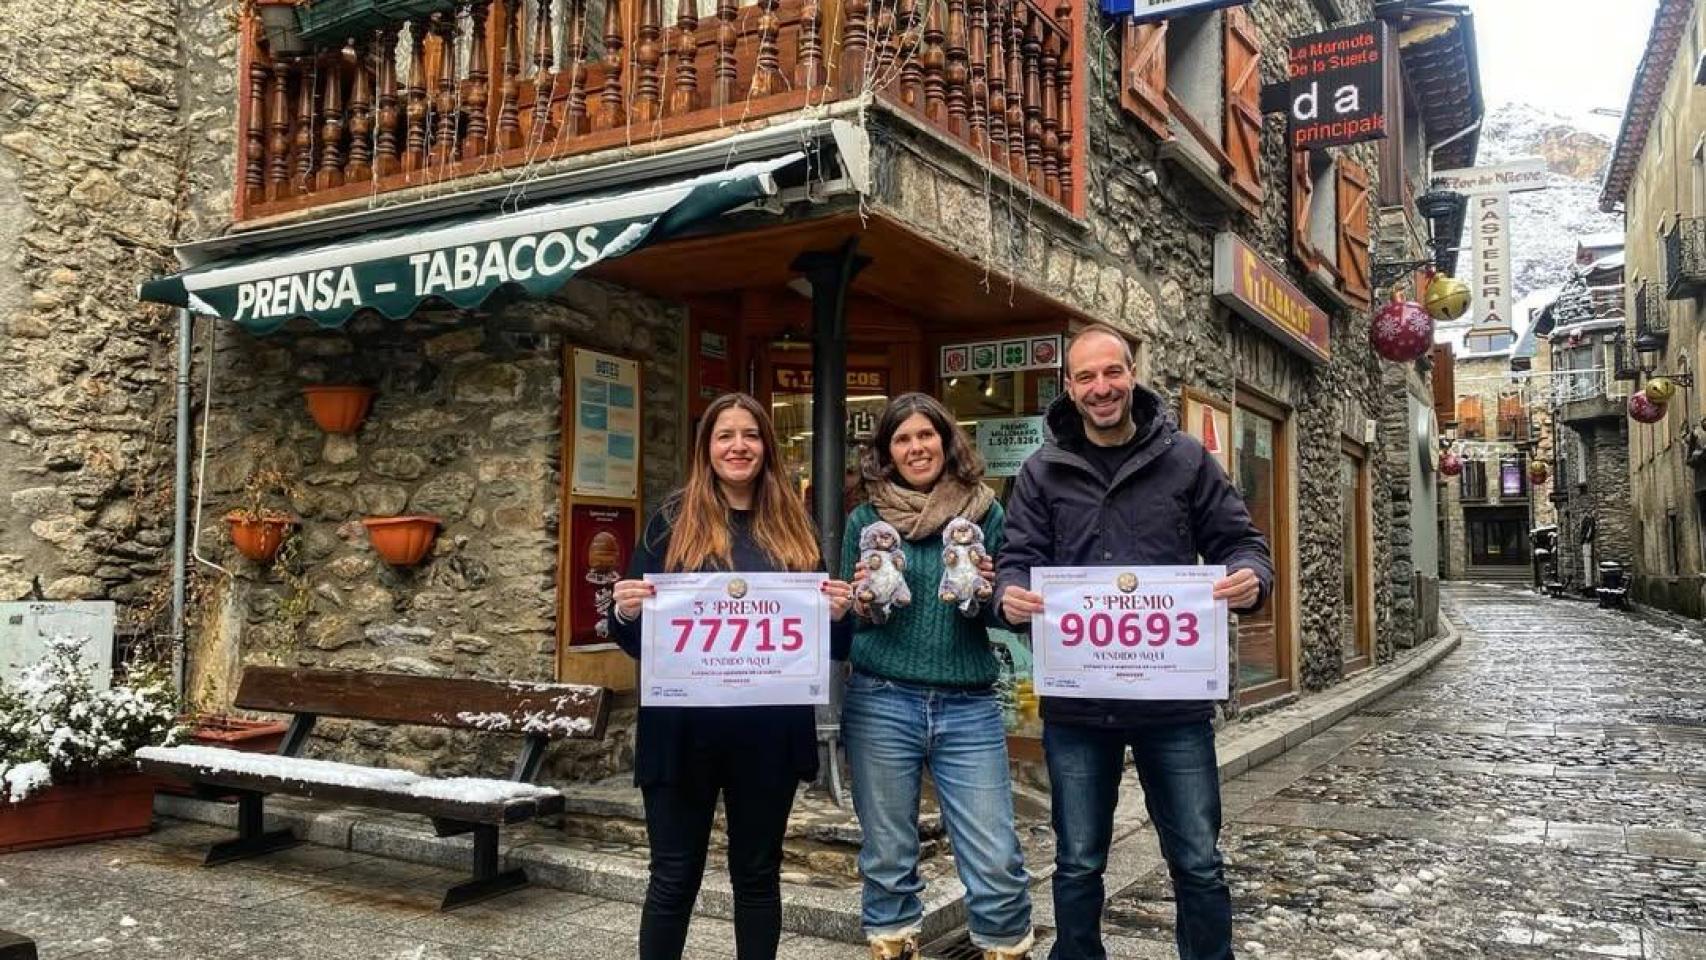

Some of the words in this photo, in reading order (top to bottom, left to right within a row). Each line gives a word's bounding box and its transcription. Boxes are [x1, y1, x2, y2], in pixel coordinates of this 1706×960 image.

[1311, 33, 1374, 56] Marmota
[1479, 198, 1503, 323] PASTELERIA
[233, 266, 362, 321] PRENSA
[409, 226, 599, 296] TABACOS
[713, 600, 781, 615] PREMIO
[1103, 595, 1174, 610] PREMIO
[671, 618, 804, 653] 77715
[1060, 612, 1200, 647] 90693
[701, 656, 744, 666] VENDIDO
[1092, 651, 1137, 660] VENDIDO
